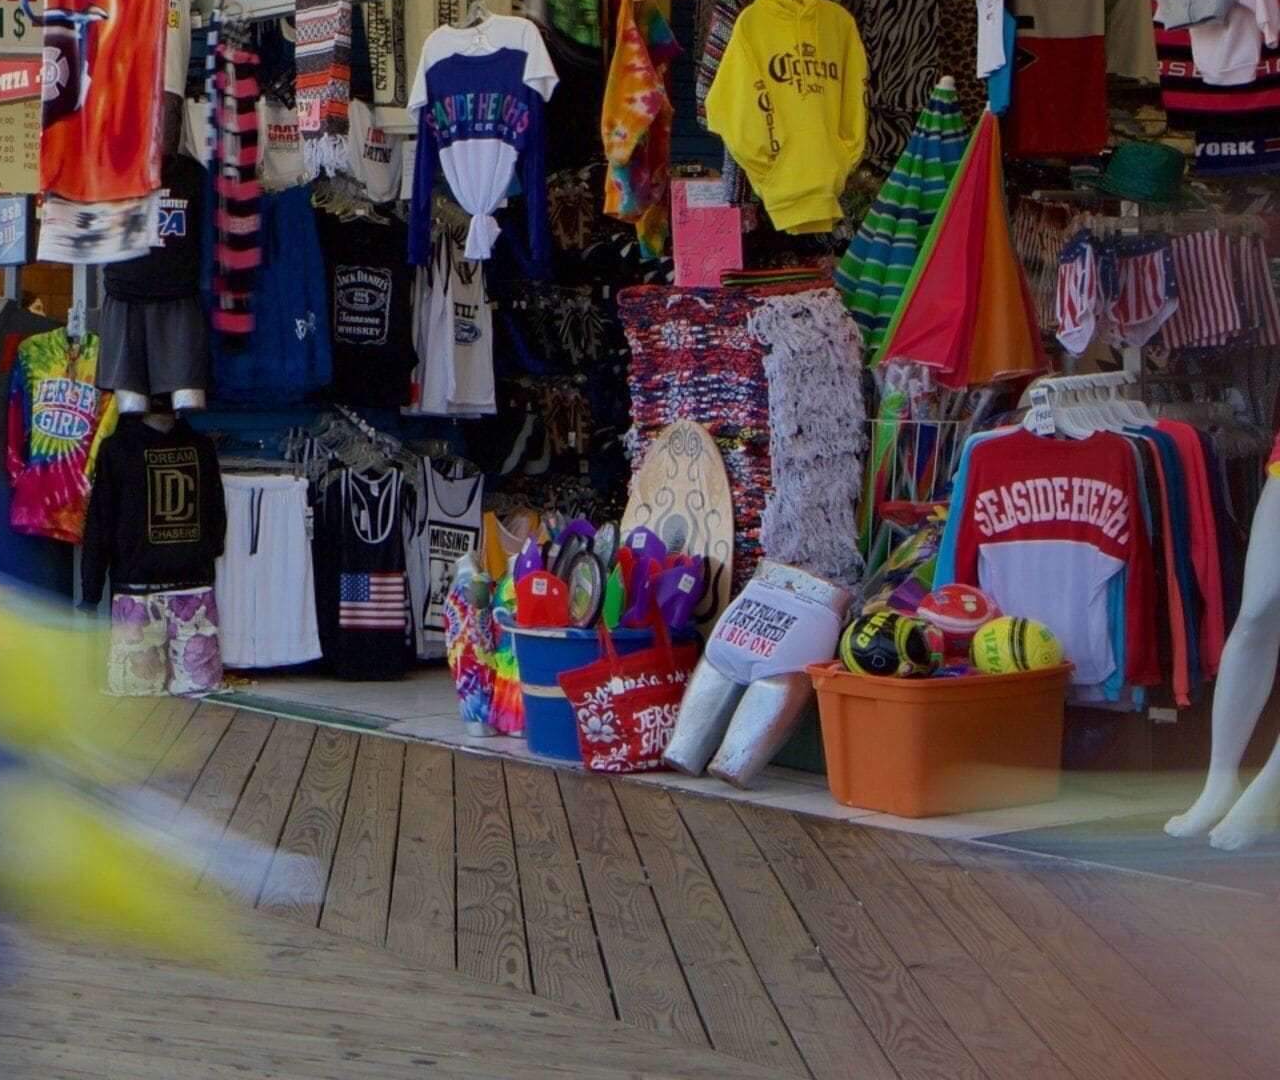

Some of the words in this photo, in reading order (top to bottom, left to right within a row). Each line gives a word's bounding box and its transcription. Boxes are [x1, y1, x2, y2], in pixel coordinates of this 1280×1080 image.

[13, 7, 25, 40] $
[424, 92, 475, 128] SEASIDE
[478, 92, 530, 134] HEIGHTS
[337, 272, 357, 287] JACK
[357, 270, 390, 291] DANIEL'S
[339, 311, 381, 325] Tennessee
[338, 326, 381, 337] WHISKEY
[40, 411, 85, 438] GIRL
[150, 452, 196, 464] DREAM
[974, 477, 1070, 536] SEASIDE
[151, 526, 199, 539] CHASERS
[430, 528, 470, 552] MISSING
[716, 626, 725, 639] A
[726, 629, 748, 648] BIG
[749, 637, 778, 658] ONE
[751, 619, 786, 642] FARTED
